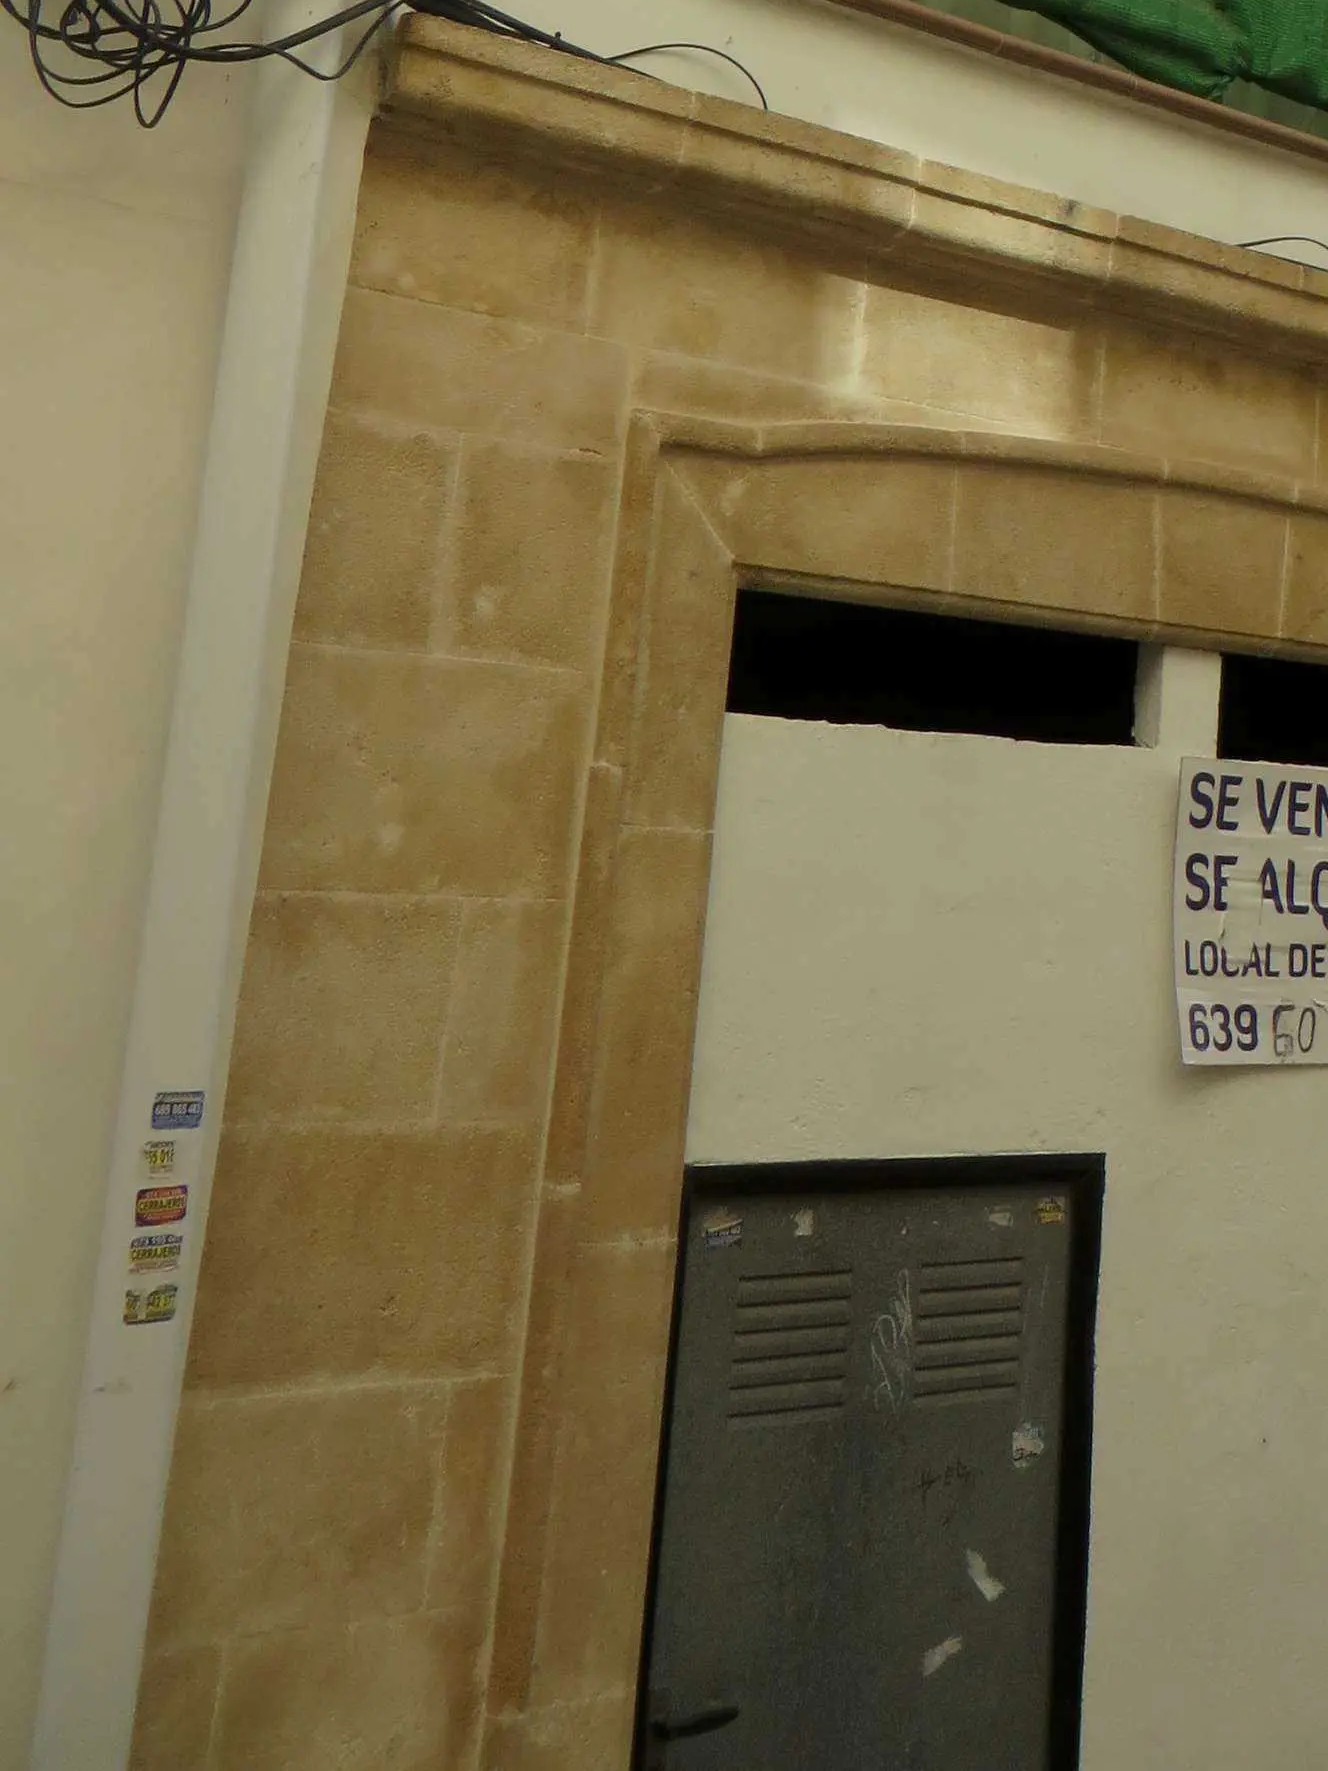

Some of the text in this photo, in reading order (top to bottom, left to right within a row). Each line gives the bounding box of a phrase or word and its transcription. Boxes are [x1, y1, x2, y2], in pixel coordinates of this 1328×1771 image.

[1189, 772, 1243, 832] SE
[1185, 852, 1239, 912] SE
[1184, 939, 1281, 978] LOCAL
[1288, 943, 1327, 979] DE
[1189, 1002, 1259, 1053] 639
